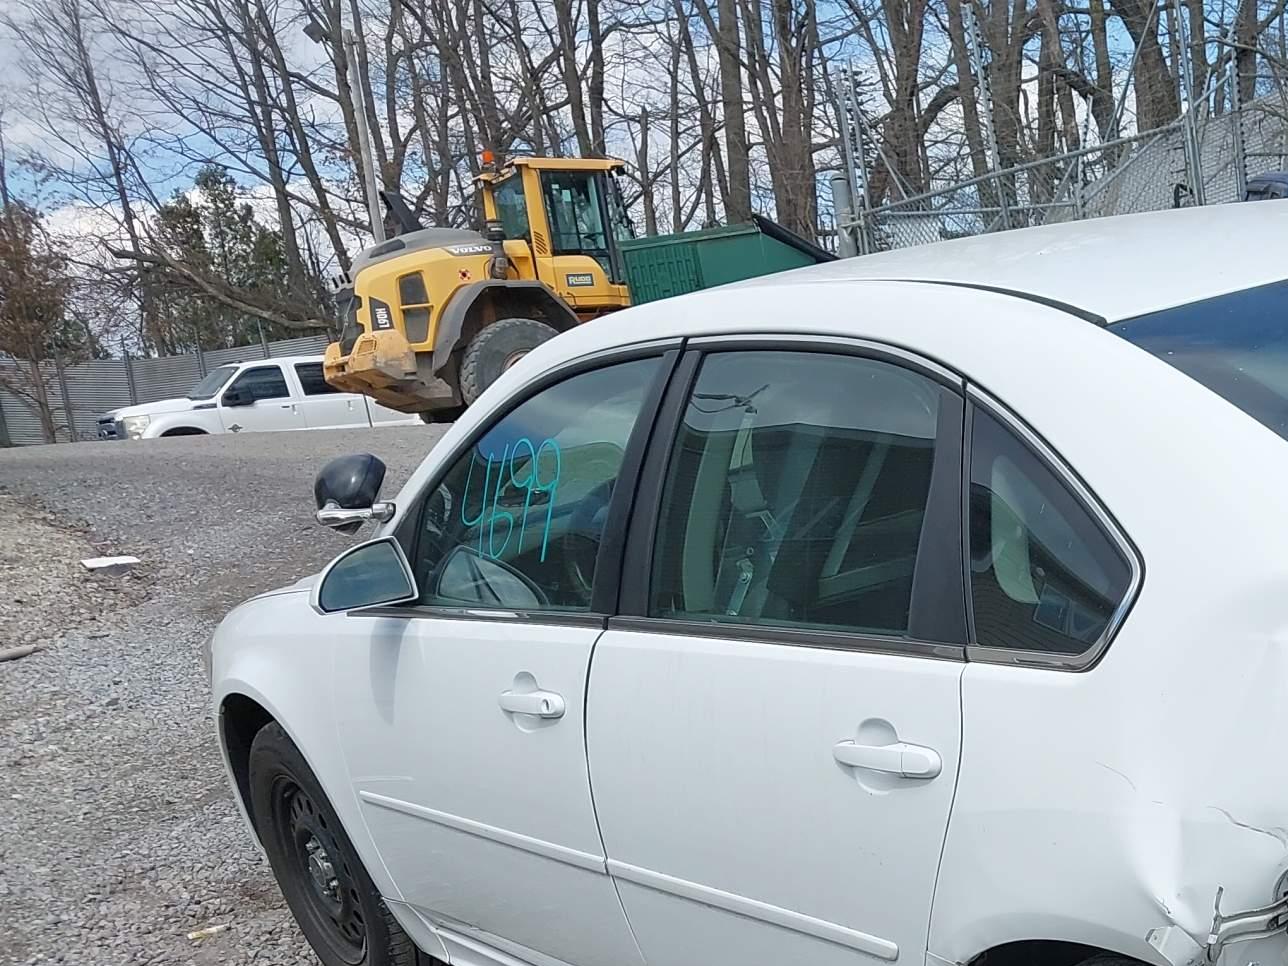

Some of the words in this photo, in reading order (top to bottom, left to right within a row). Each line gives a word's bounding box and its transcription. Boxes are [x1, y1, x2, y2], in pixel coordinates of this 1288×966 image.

[448, 245, 492, 254] VOLVO
[375, 307, 390, 328] L90H
[461, 437, 561, 563] 4699
